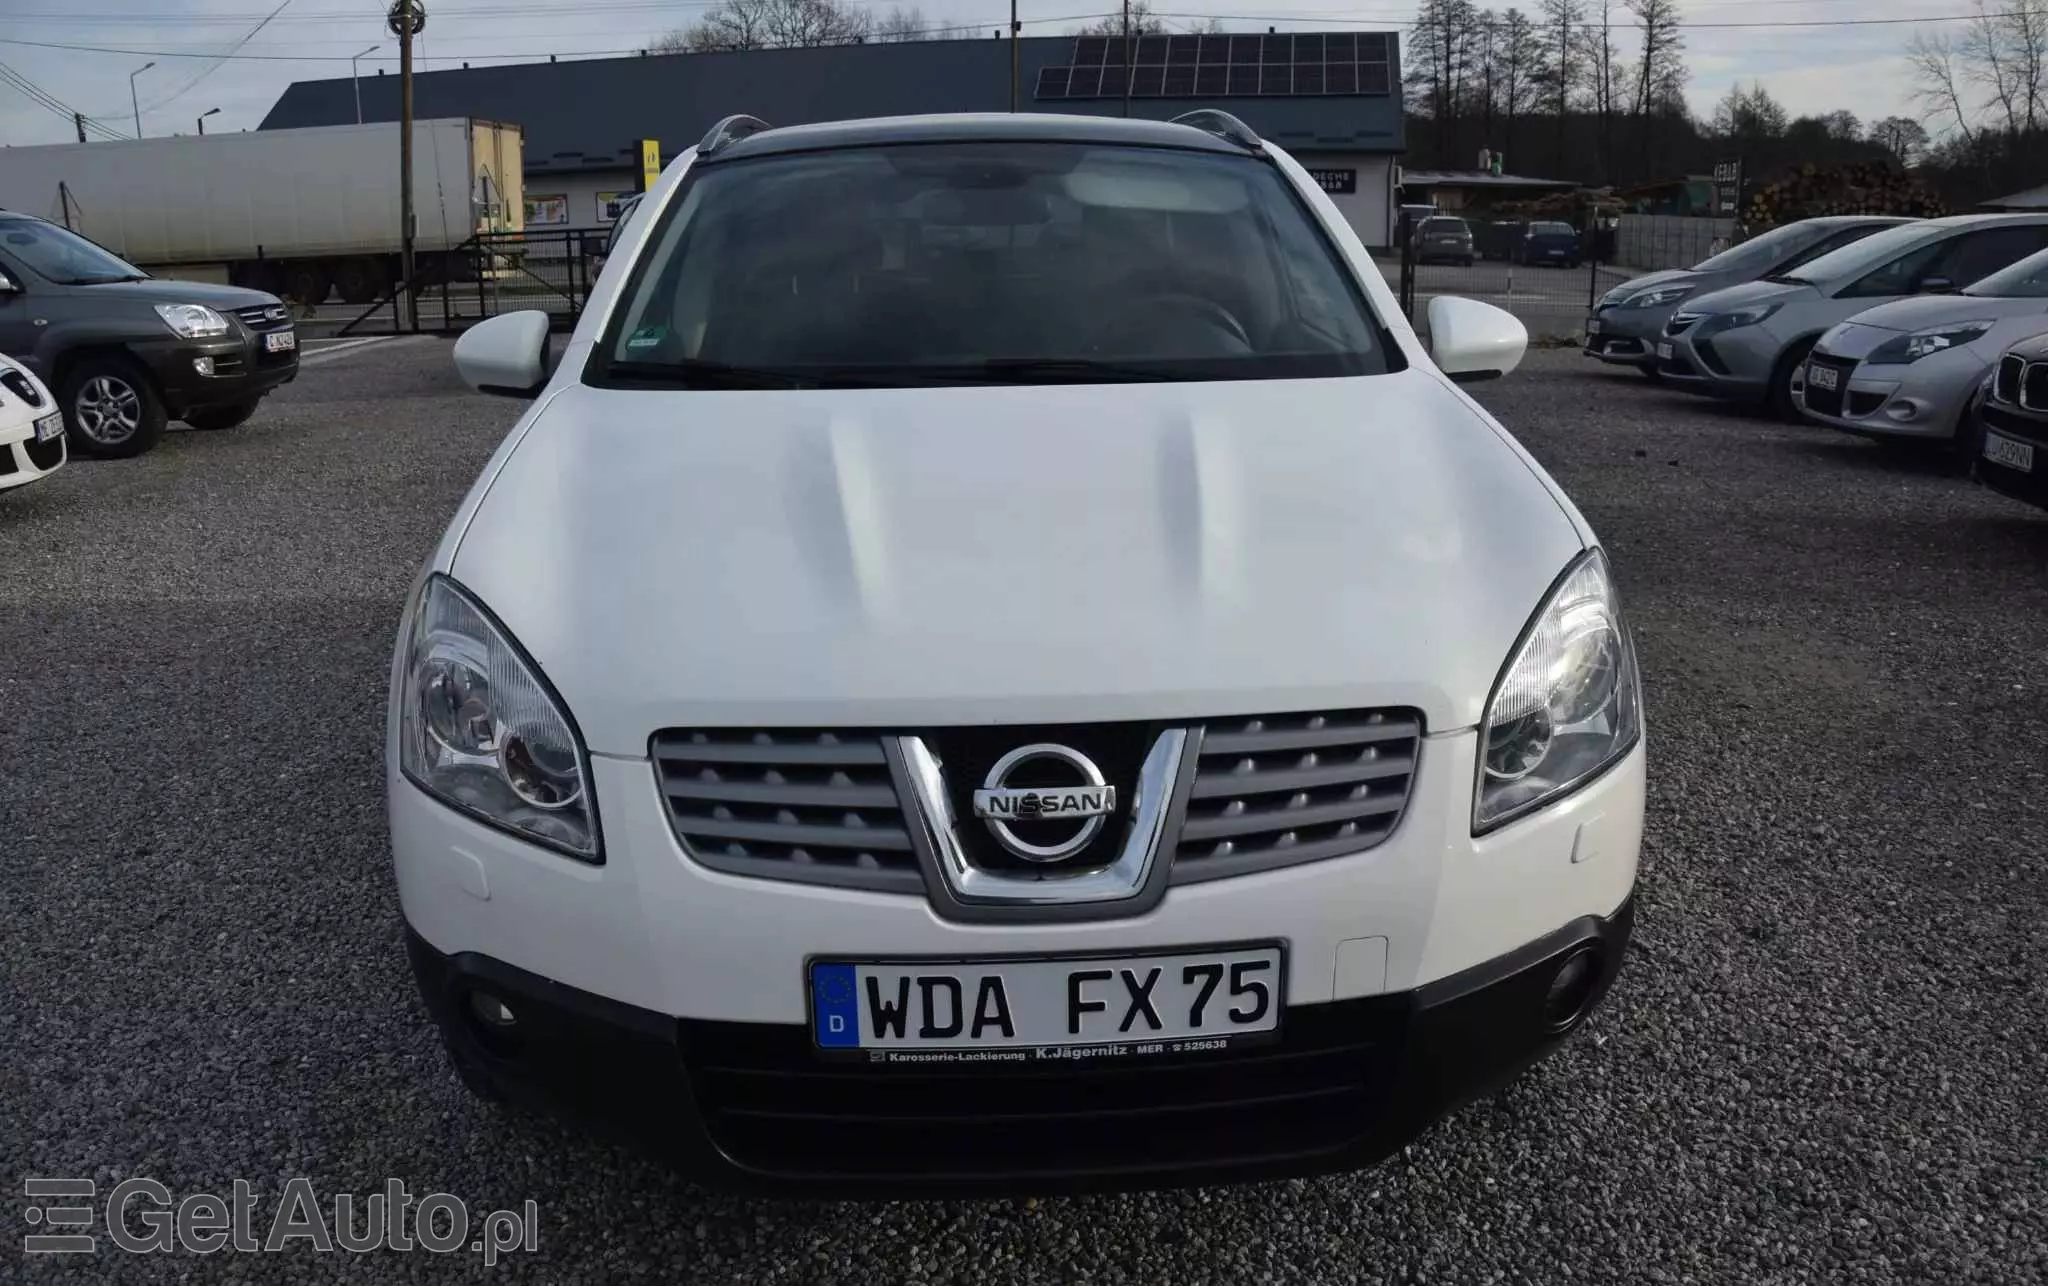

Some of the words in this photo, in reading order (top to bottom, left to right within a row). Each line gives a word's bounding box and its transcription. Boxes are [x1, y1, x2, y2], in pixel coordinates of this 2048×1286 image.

[989, 793, 1100, 813] NISSAN
[865, 975, 1015, 1039] WDA
[1067, 967, 1163, 1034] FX
[1182, 959, 1271, 1027] 75
[829, 1014, 845, 1033] D
[889, 1051, 1026, 1062] Karosserie-Lackierung
[1036, 1044, 1128, 1060] K.Jägernitz
[1137, 1044, 1163, 1054] MER
[1184, 1040, 1227, 1051] 525638
